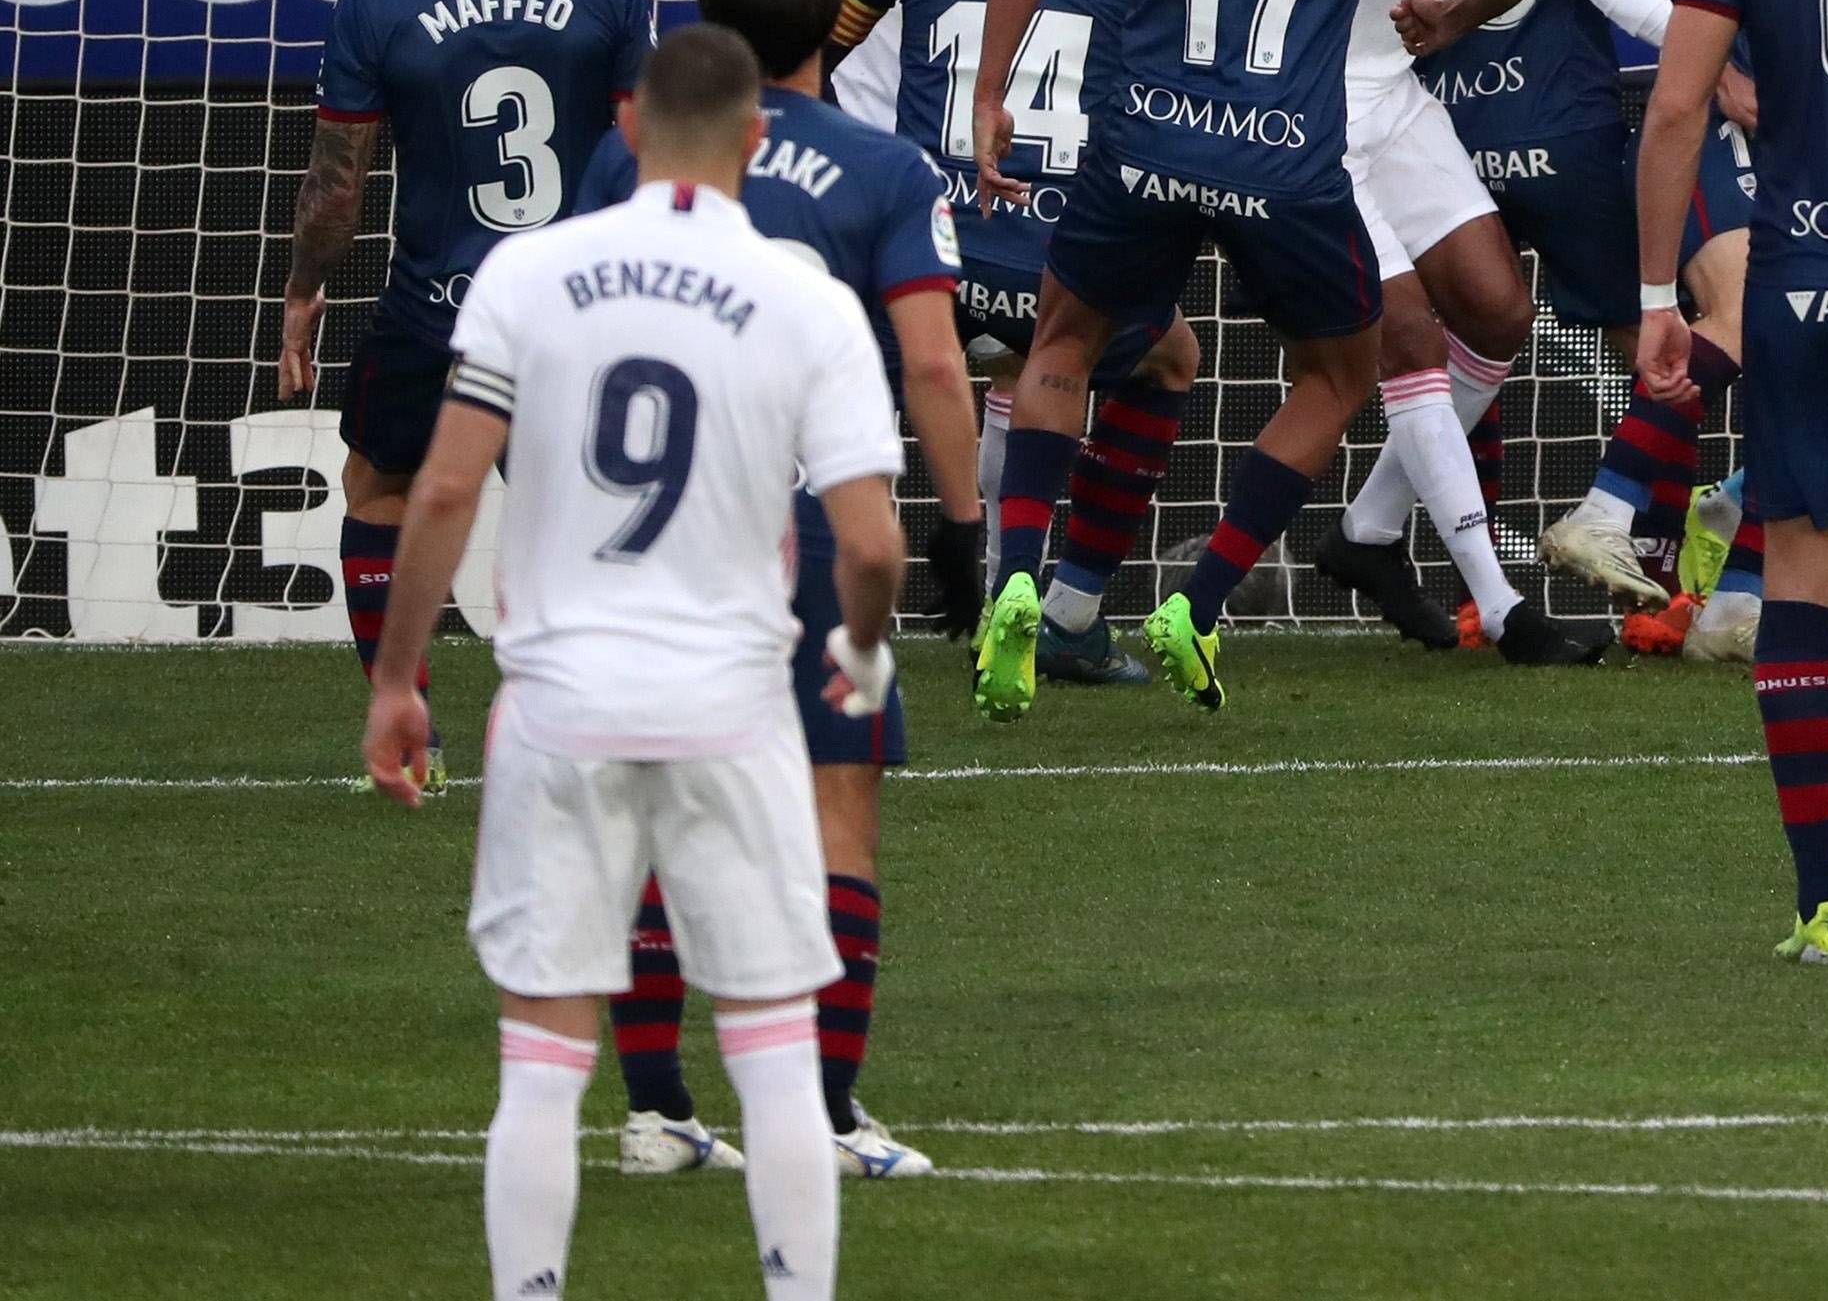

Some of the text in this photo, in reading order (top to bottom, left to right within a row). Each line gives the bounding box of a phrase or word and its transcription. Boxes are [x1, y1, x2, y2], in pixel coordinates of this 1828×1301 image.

[461, 65, 563, 233] 3
[929, 0, 1095, 177] 14
[1124, 82, 1307, 149] SOMMOS
[1141, 172, 1271, 220] AMBAR
[564, 258, 758, 337] BENZEMA
[582, 355, 699, 564] 9
